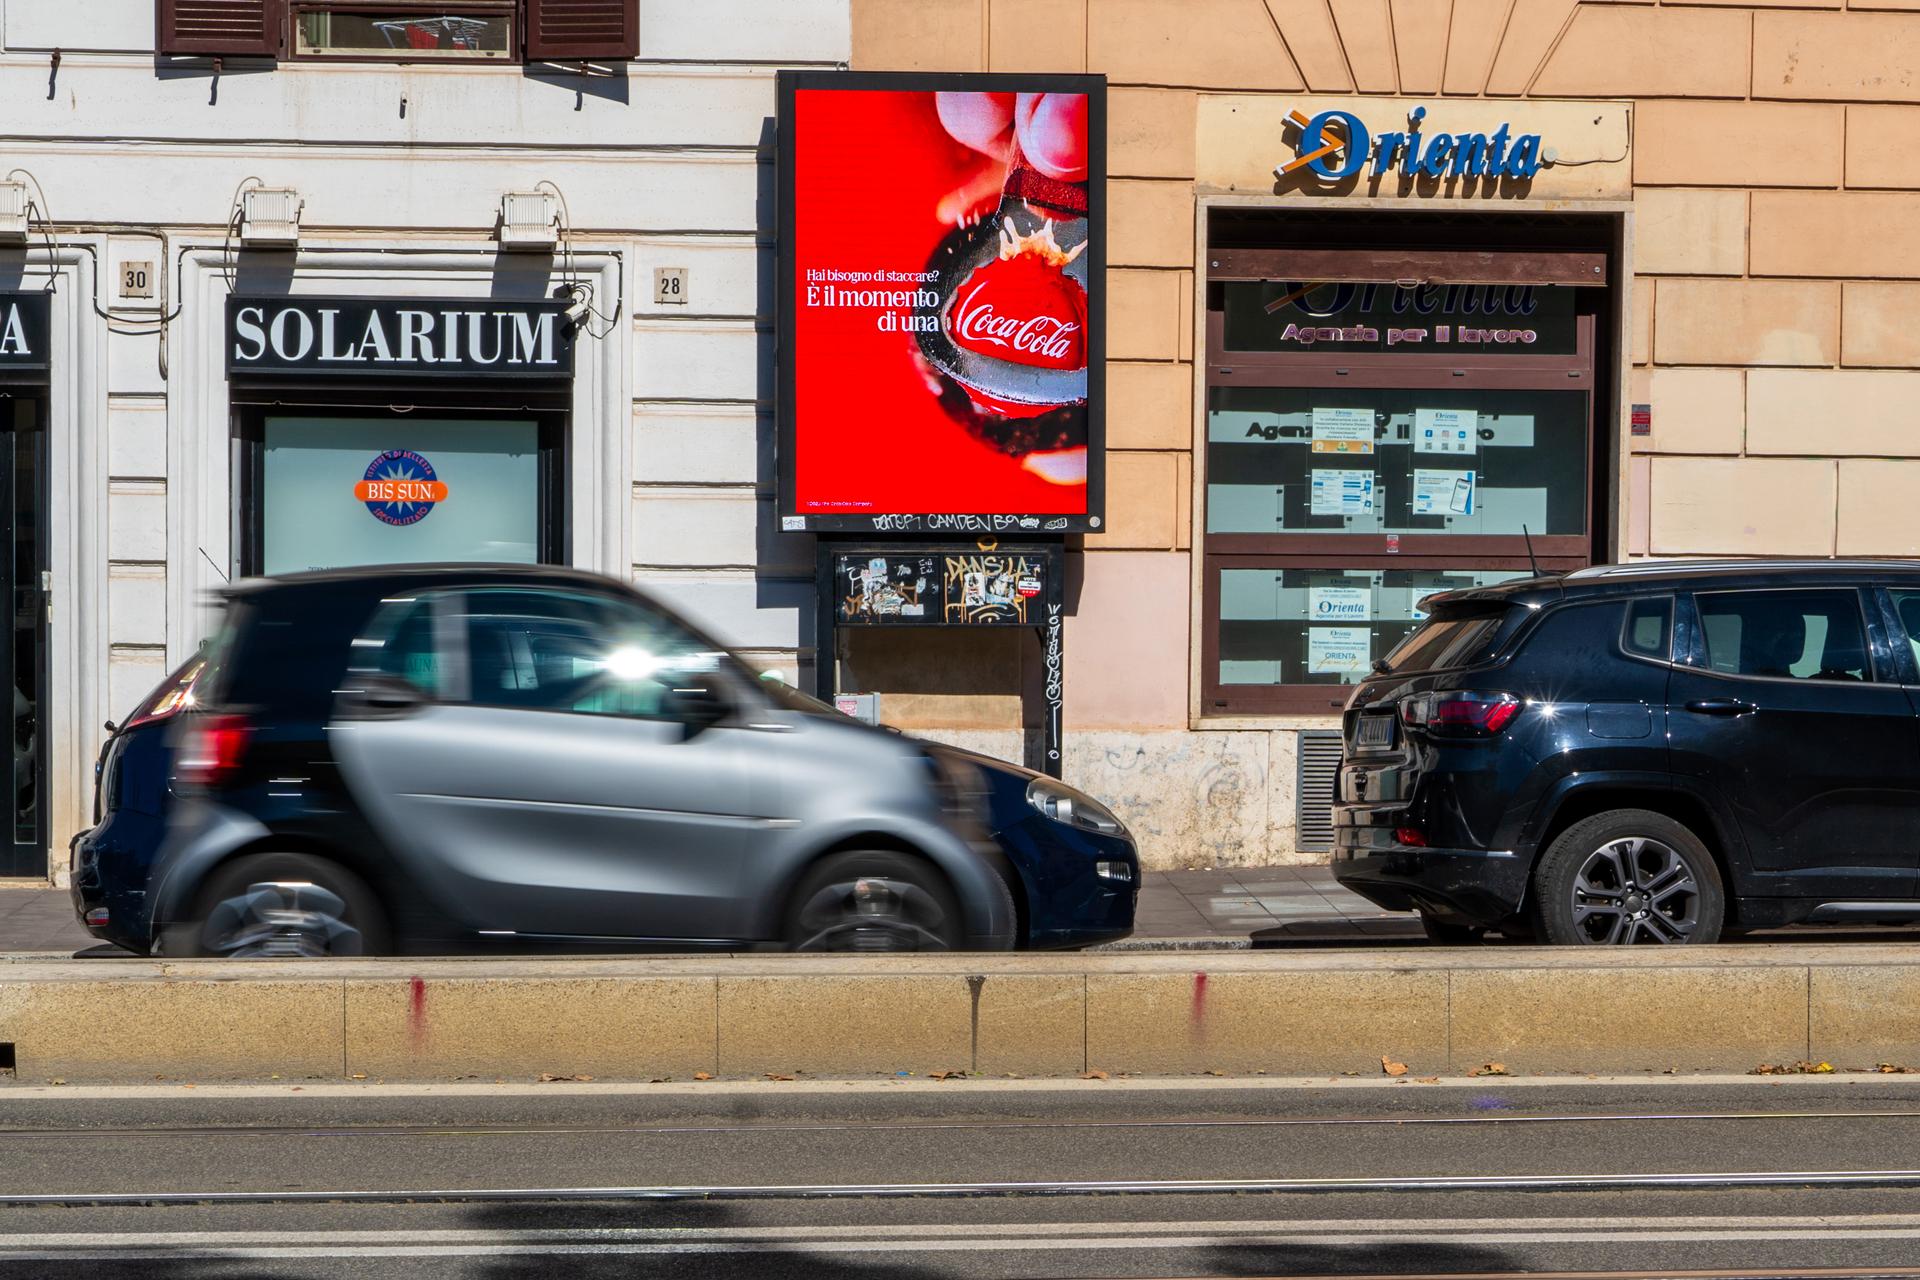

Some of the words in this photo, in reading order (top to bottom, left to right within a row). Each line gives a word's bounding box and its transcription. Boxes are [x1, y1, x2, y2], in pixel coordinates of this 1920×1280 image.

[1302, 106, 1543, 180] Orienta
[126, 271, 146, 288] 30
[661, 277, 680, 295] 28
[807, 269, 825, 281] Hai
[828, 269, 871, 283] bisogno
[874, 270, 884, 281] di
[886, 270, 939, 282] staccare?
[807, 282, 820, 306] È
[824, 285, 835, 307] il
[838, 288, 939, 307] momento
[0, 302, 31, 354] A
[877, 311, 897, 332] di
[901, 316, 939, 332] una
[961, 304, 1080, 359] Coca-Cola
[235, 307, 558, 364] SOLARIUM
[1280, 323, 1379, 344] Agenzia
[1387, 327, 1428, 345] per
[1458, 325, 1537, 344] lavoro
[367, 482, 394, 499] BIS
[397, 483, 432, 500] SUN
[373, 507, 429, 526] SPECIALIZZATO
[927, 513, 991, 532] CAMDEN
[1319, 600, 1365, 613] Orienta
